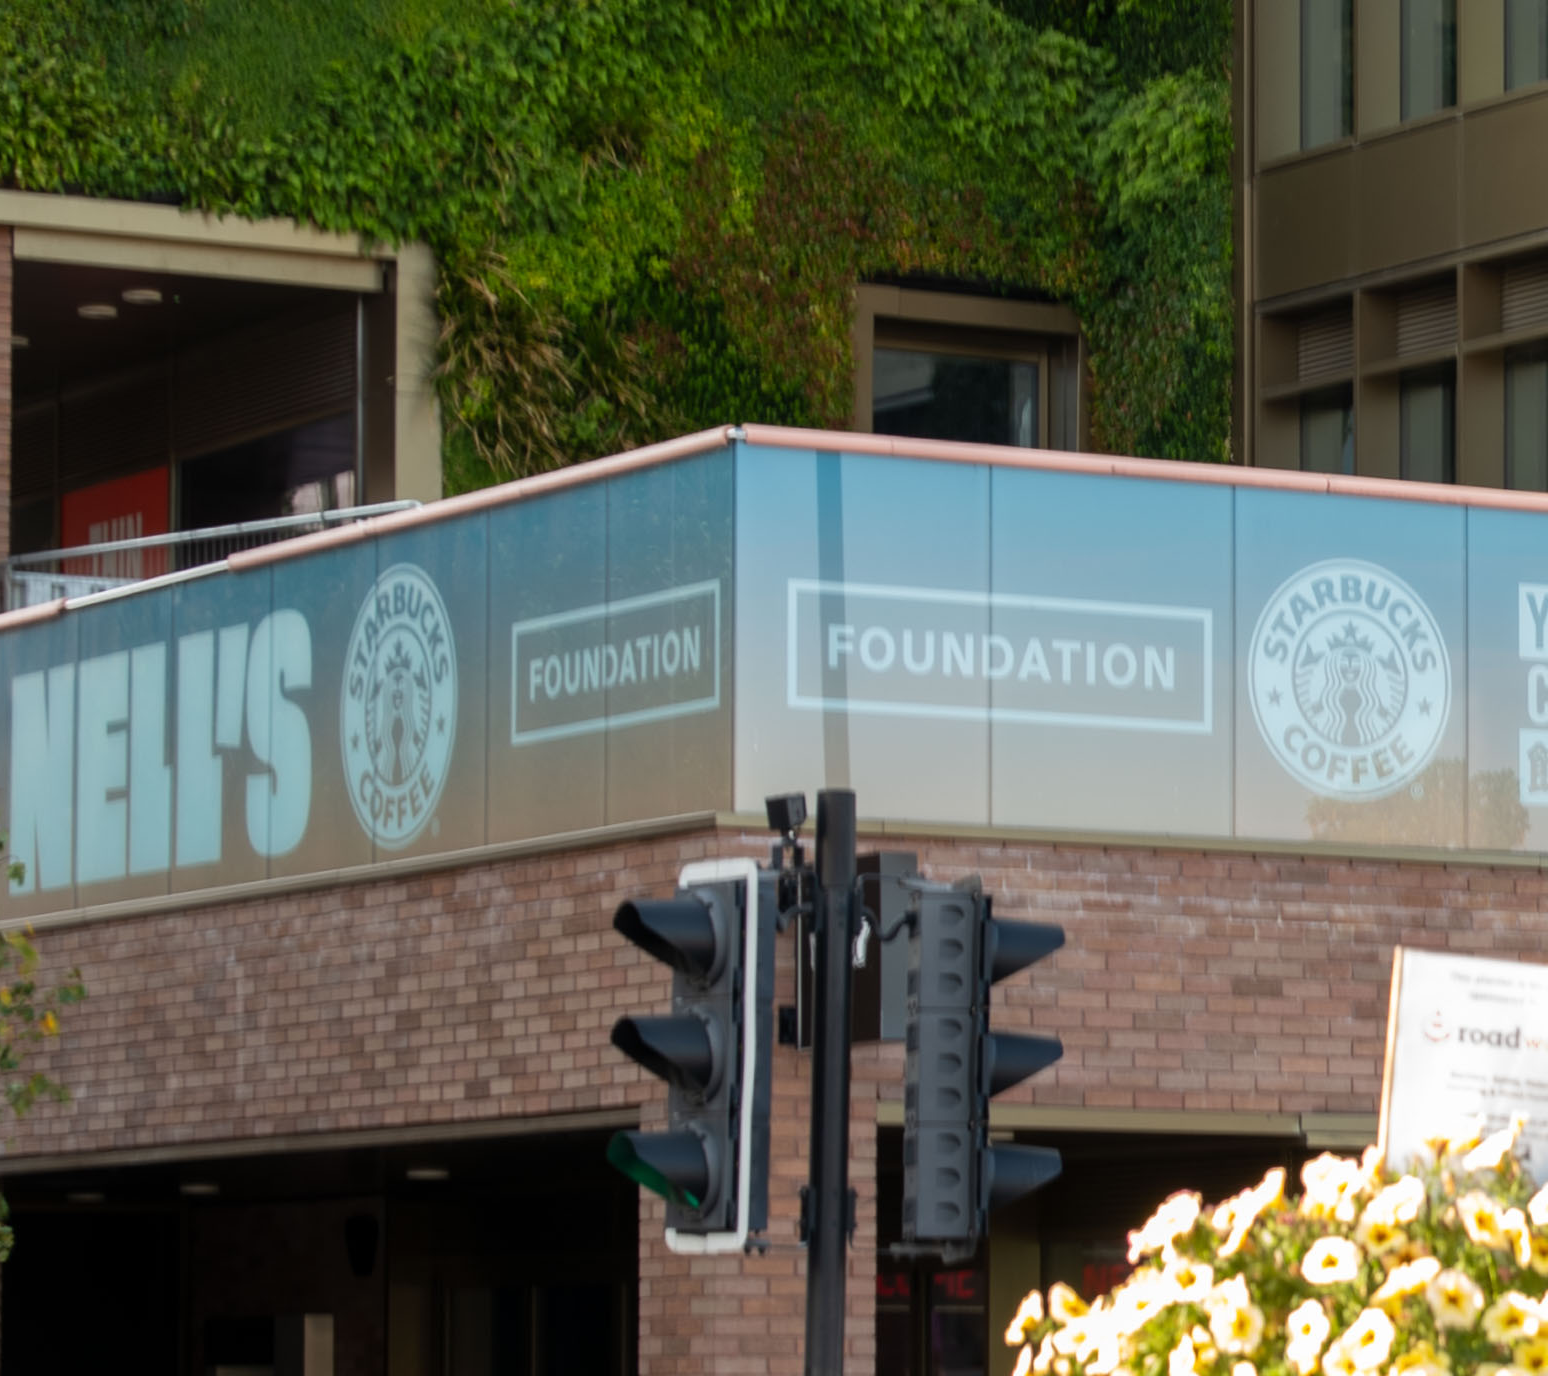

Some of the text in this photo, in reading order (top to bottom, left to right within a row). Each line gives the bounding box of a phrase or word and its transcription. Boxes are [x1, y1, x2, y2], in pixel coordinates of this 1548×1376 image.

[349, 581, 449, 702] STARBUCKS
[827, 623, 1176, 692] FOUNDATION
[1263, 574, 1437, 674] STARBUCKS
[529, 625, 701, 704] FOUNDATION
[8, 608, 313, 898] NELL'S
[1283, 723, 1415, 785] COFFEE
[359, 761, 434, 830] COFFEE
